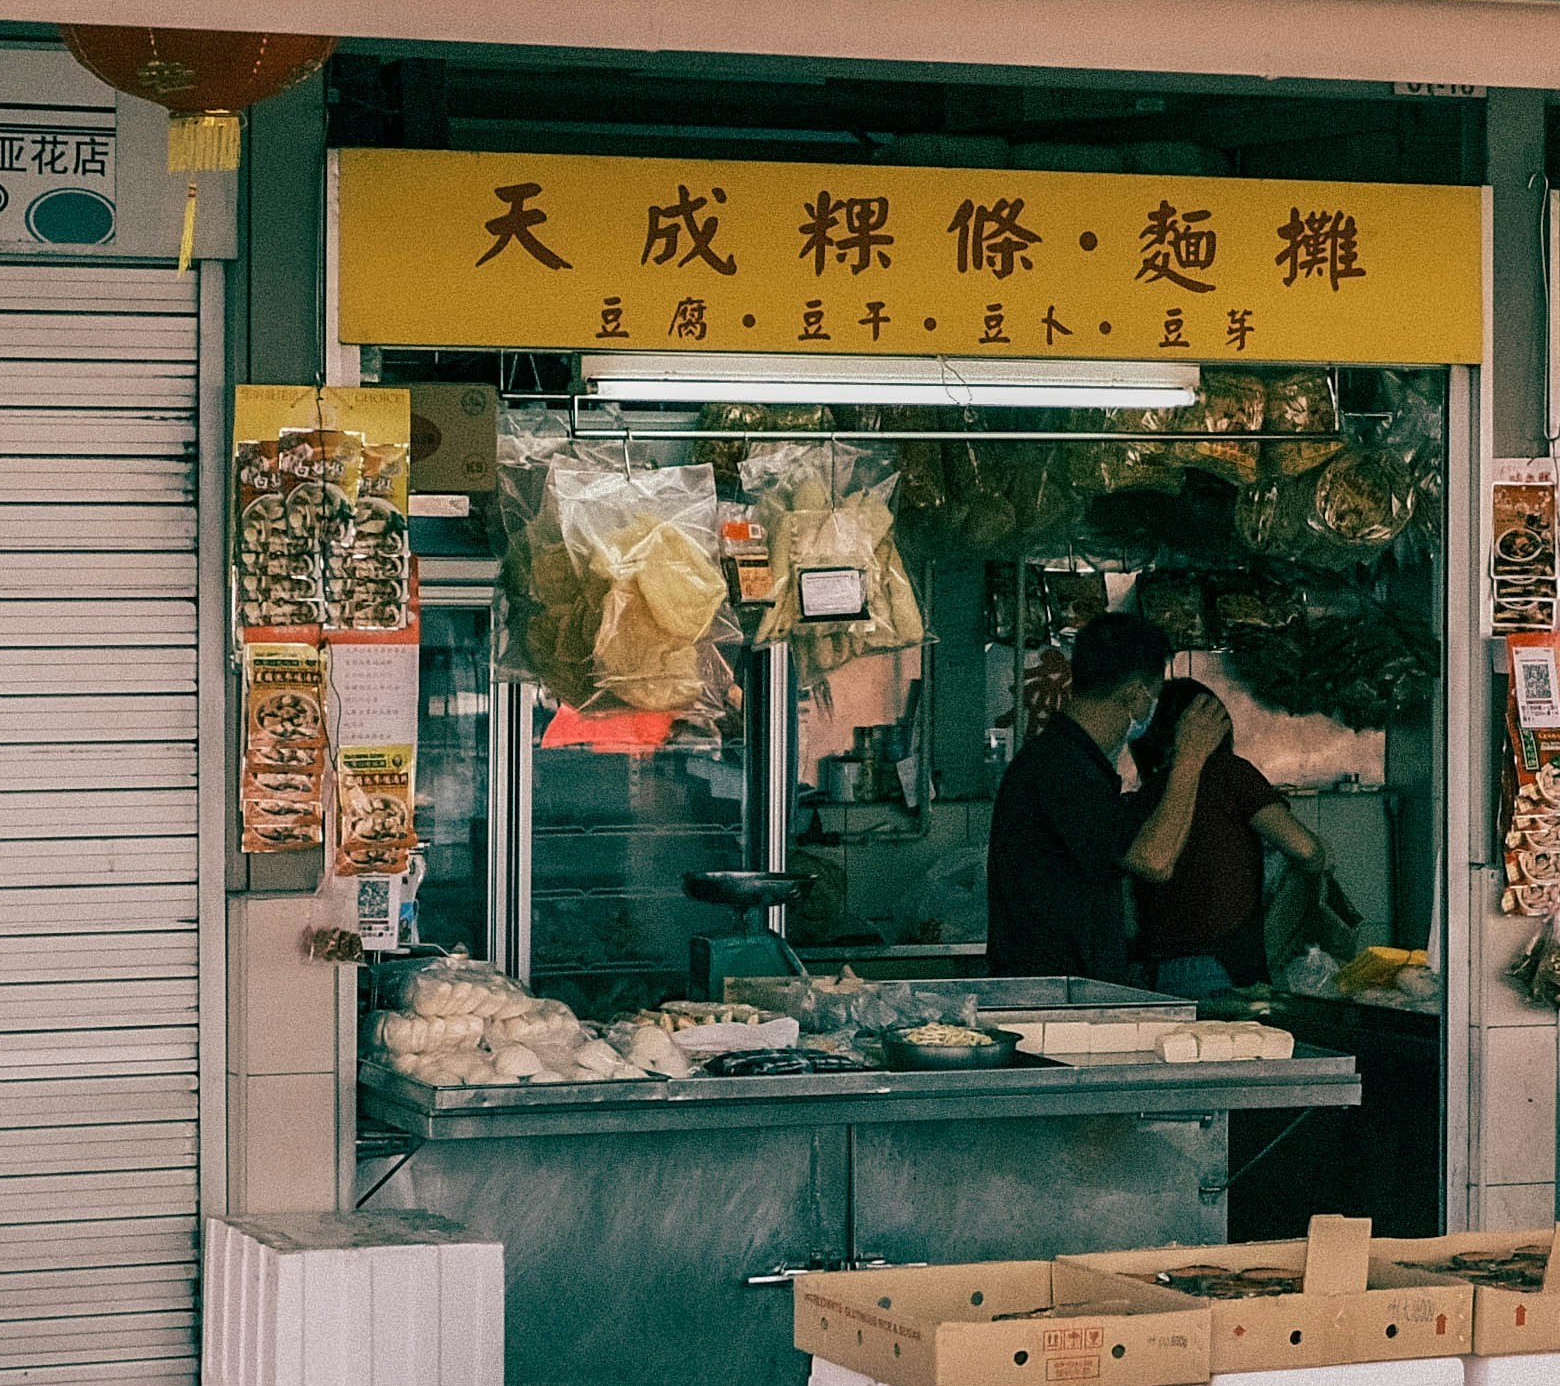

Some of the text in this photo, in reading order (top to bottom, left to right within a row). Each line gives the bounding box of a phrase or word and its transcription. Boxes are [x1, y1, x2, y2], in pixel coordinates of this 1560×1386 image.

[475, 180, 1368, 295] 天成粿條 麵攤
[594, 296, 1256, 352] 豆腐 豆干 豆卜 豆芽
